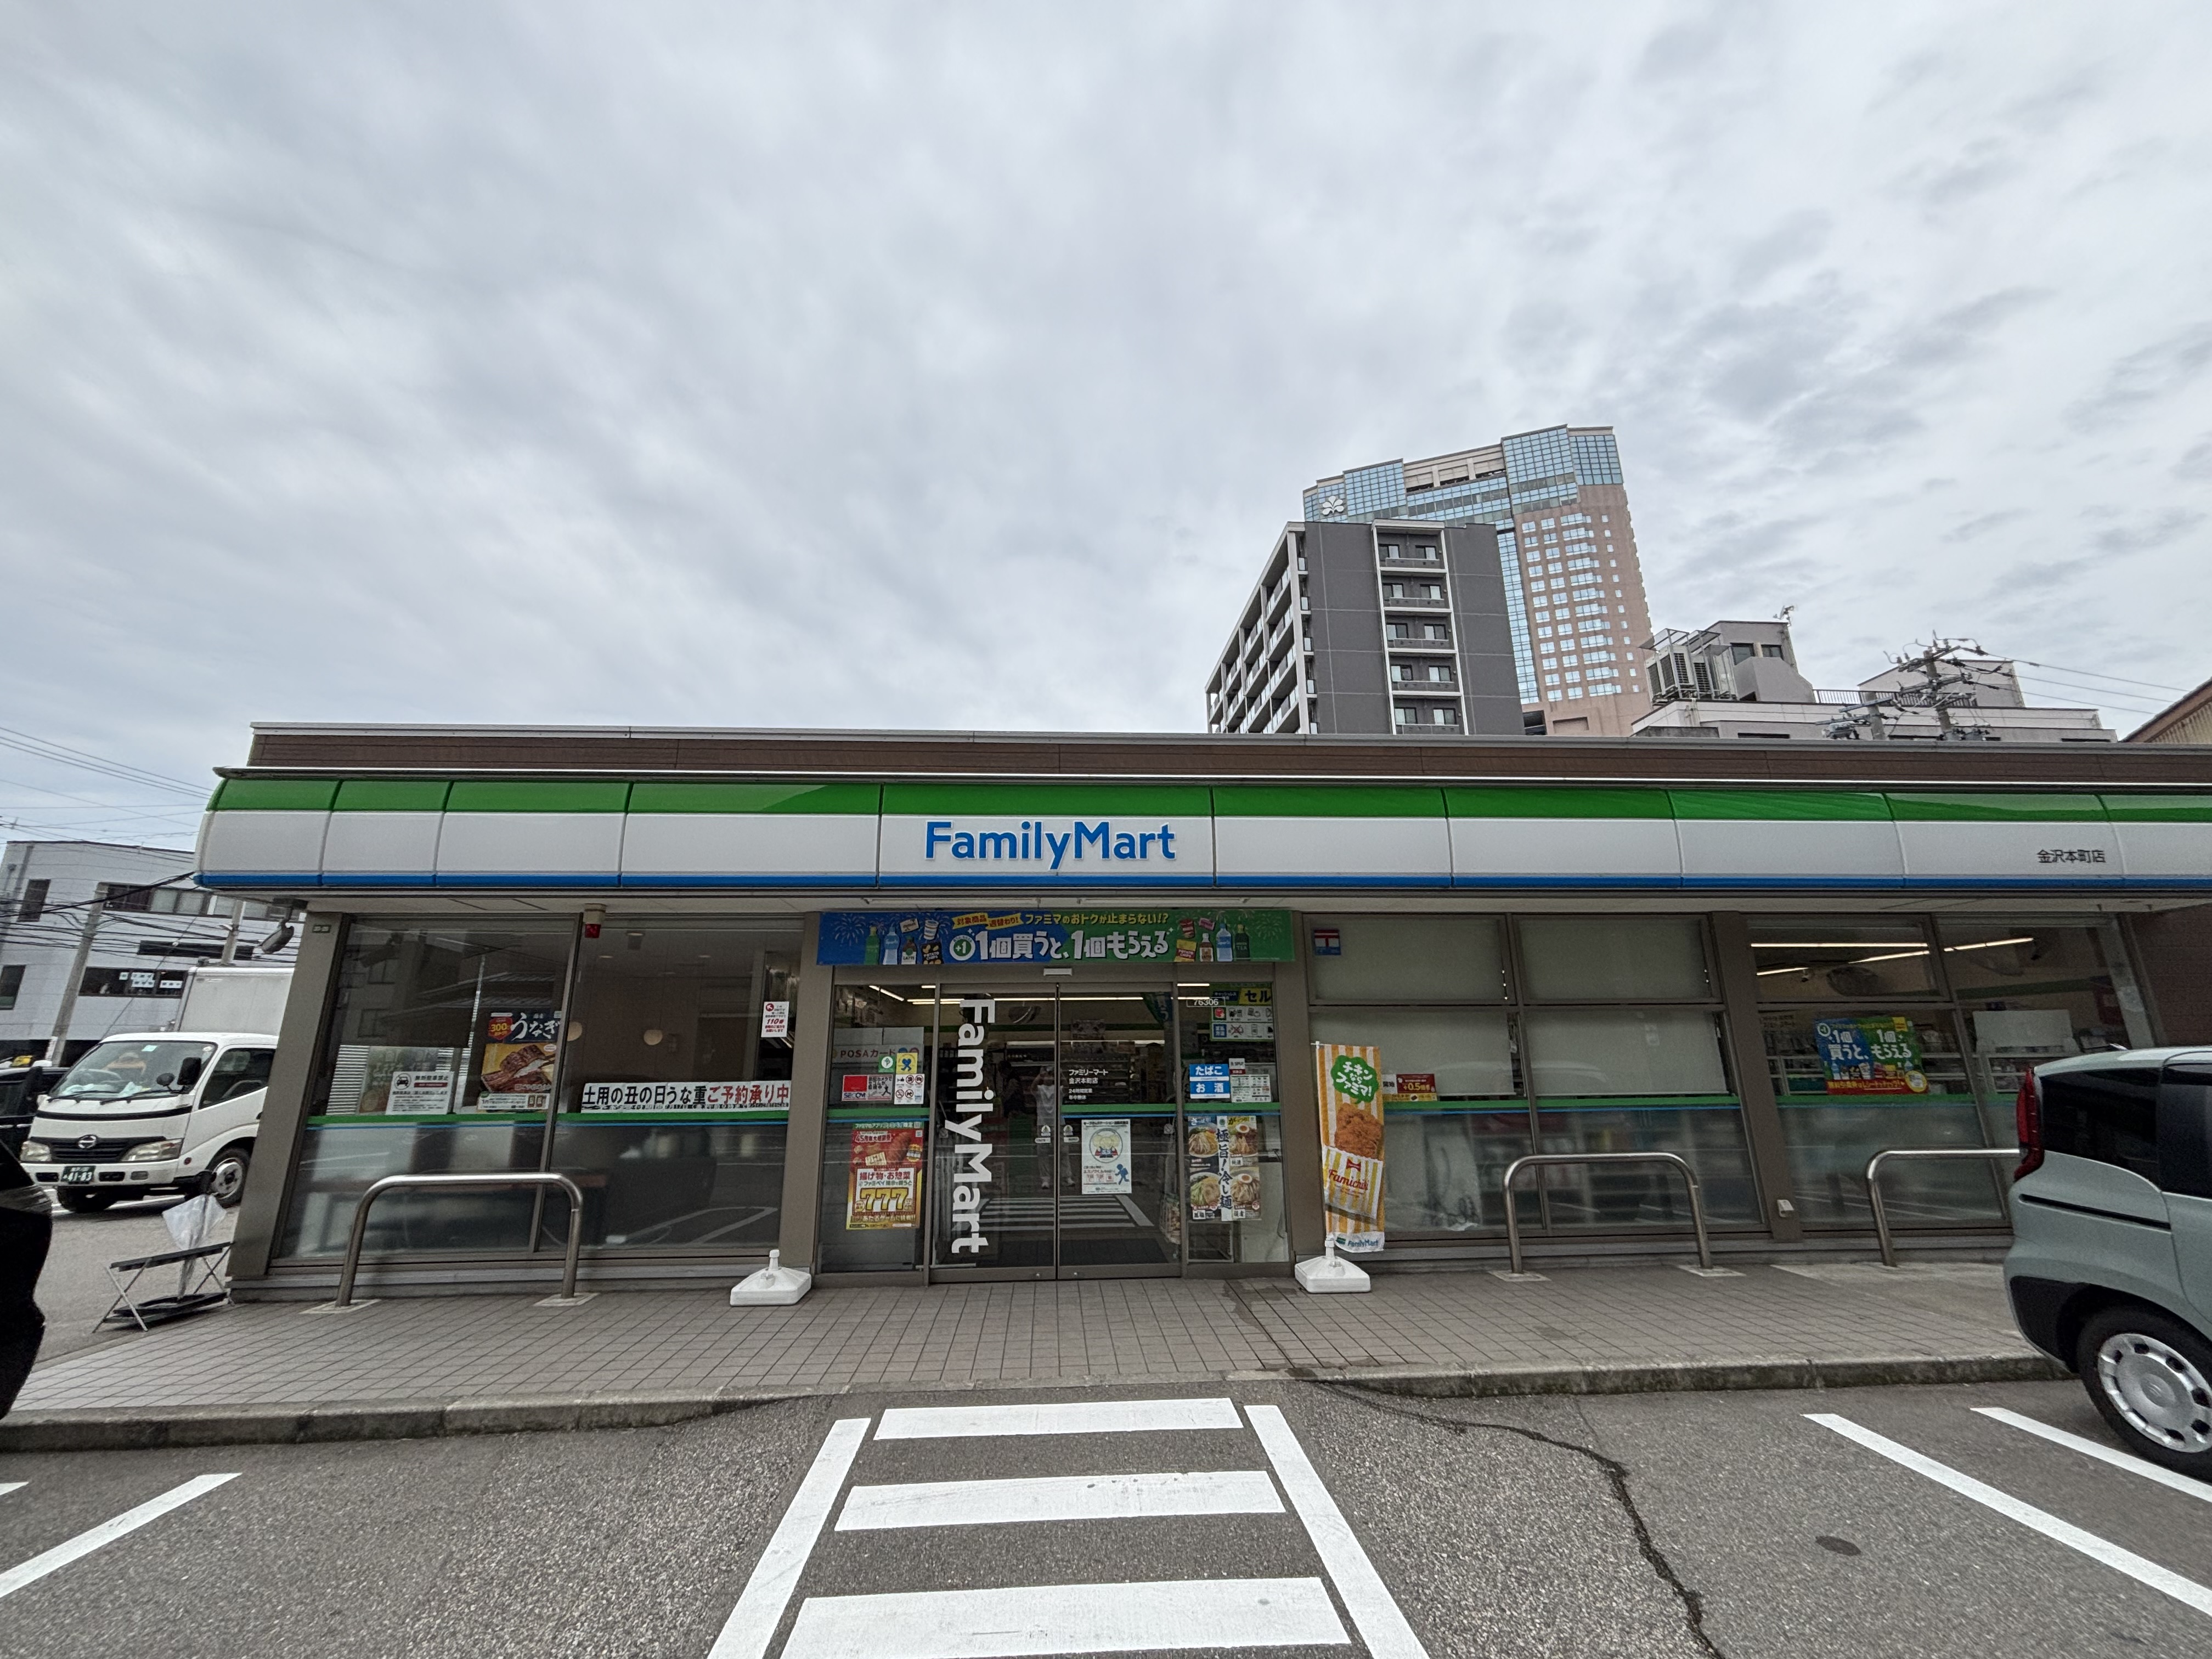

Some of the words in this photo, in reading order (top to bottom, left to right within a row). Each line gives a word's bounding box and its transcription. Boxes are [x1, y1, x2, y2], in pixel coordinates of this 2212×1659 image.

[926, 821, 1176, 871] FamilyMart
[2036, 849, 2106, 864] 金沢本町店
[957, 915, 987, 926] 対象商品
[1025, 913, 1169, 925] ファミマのおトクが止まらない!?
[490, 1023, 507, 1031] 300
[510, 1012, 560, 1041] うなぎ
[840, 1049, 896, 1058] POSAカード
[1870, 1043, 1912, 1060] もらえる
[1195, 1065, 1223, 1076] たばこ
[1342, 1062, 1373, 1080] チキン
[1350, 1073, 1362, 1084] なら
[1336, 1072, 1372, 1097] ファミマ!
[582, 1084, 789, 1105] 土用の丑の日うな重ご予約承り中
[944, 999, 996, 1254] FamilyMart
[859, 1187, 909, 1211] 777
